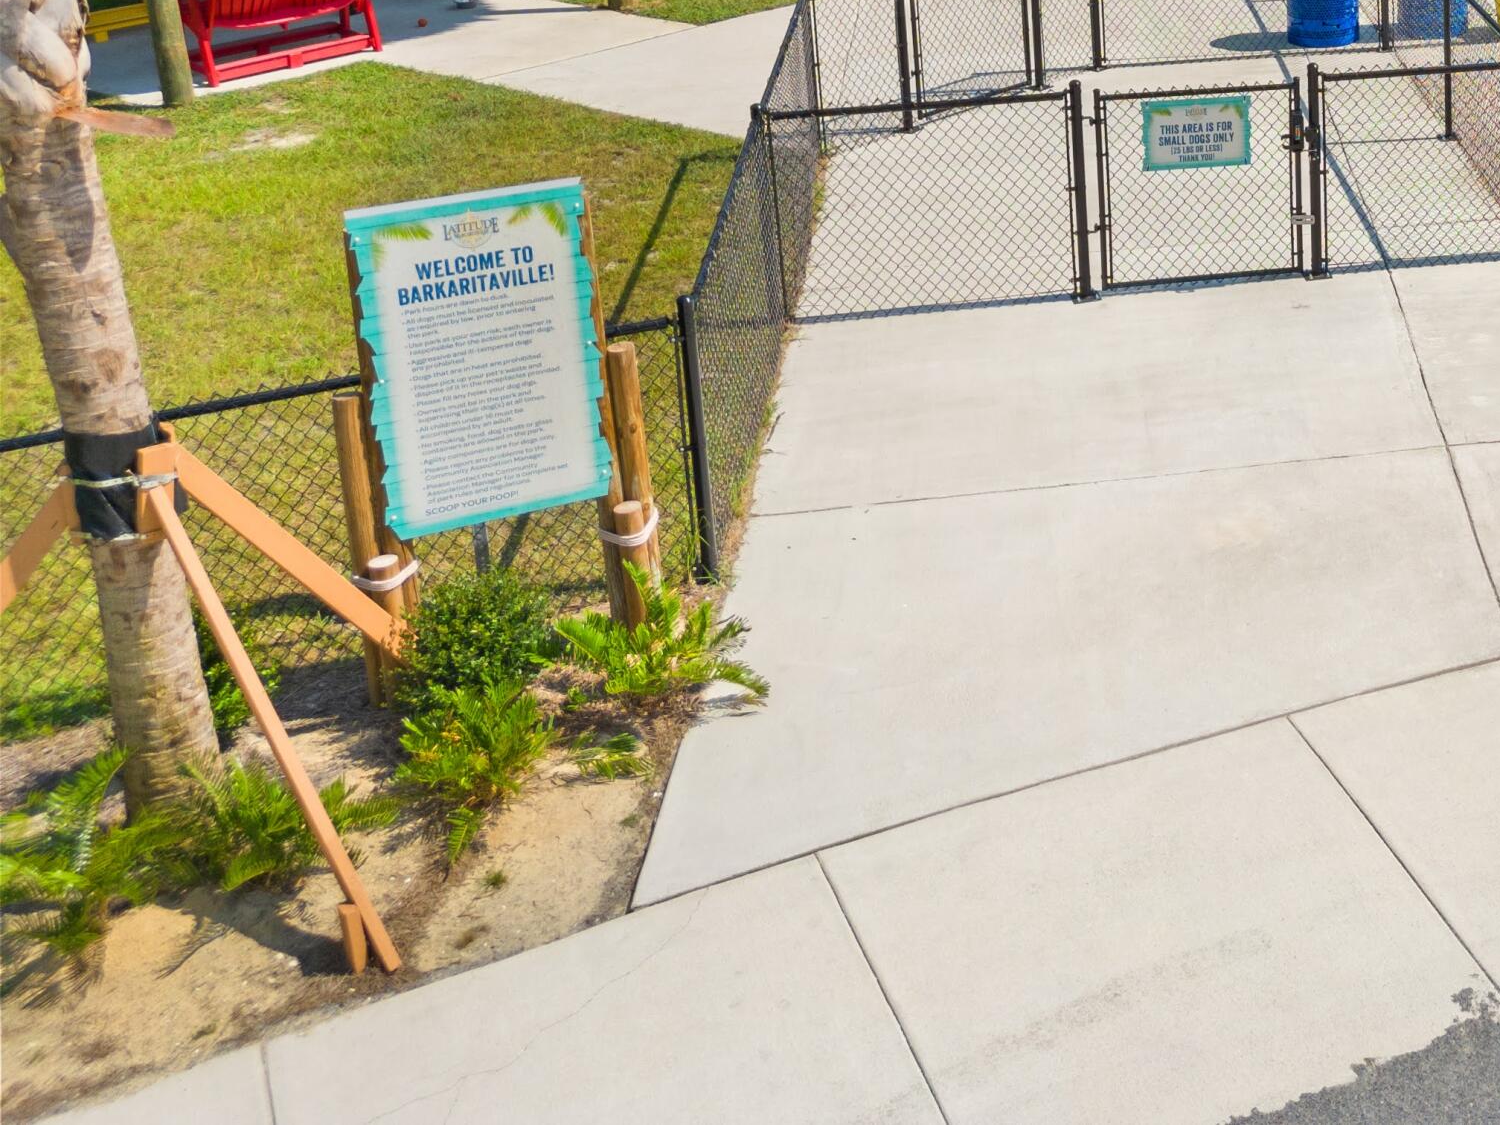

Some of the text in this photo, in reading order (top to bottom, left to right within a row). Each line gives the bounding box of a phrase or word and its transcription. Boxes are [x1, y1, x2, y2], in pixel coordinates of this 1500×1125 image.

[1158, 132, 1234, 146] SMALL DOGS ONLY
[1160, 121, 1232, 135] THIS AREA IS FOR
[1179, 153, 1215, 162] THANK YOU!
[1183, 146, 1195, 154] LBS
[1196, 145, 1204, 153] OR
[442, 217, 500, 242] LATITUDE
[415, 245, 533, 281] WELCOME TO
[397, 263, 555, 306] BARKARITAVILLE!
[403, 307, 421, 315] Park
[422, 303, 444, 312] hours
[458, 297, 479, 306] dawn
[416, 314, 434, 324] dogs
[435, 310, 455, 319] must
[467, 303, 499, 314] licensed
[514, 294, 554, 306] inoculated
[416, 319, 449, 331] required
[476, 311, 494, 321] prior
[504, 304, 536, 316] entering
[408, 342, 453, 356] responsible
[480, 333, 507, 343] actions
[518, 328, 535, 336] their
[536, 324, 555, 334] dogs.
[423, 337, 441, 347] park
[451, 334, 467, 342] your
[502, 324, 521, 332] each
[521, 320, 544, 328] owner
[410, 338, 532, 366] Aggressive and ill-tempered dogs
[412, 372, 431, 382] Dogs
[432, 369, 448, 377] that
[471, 362, 488, 370] heat
[413, 381, 438, 390] Please
[439, 378, 455, 387] pick
[467, 373, 484, 381] your
[505, 365, 527, 373] waste
[414, 387, 444, 399] dispose
[482, 372, 525, 386] receptacles
[527, 366, 560, 378] provided.
[415, 397, 440, 406] Please
[452, 393, 466, 401] any
[466, 388, 487, 397] holes
[488, 386, 505, 394] your
[506, 382, 521, 391] dog
[416, 389, 532, 416] Owners must the park and
[417, 409, 461, 424] supervising
[461, 406, 479, 414] their
[429, 419, 460, 430] children
[461, 415, 483, 424] under
[494, 409, 513, 417] must
[487, 428, 501, 437] dog
[502, 424, 524, 432] treats
[533, 418, 553, 428] glass
[419, 424, 471, 440] accompanied
[421, 442, 462, 455] containers
[476, 434, 504, 445] allowed
[423, 455, 446, 466] Agility
[447, 446, 494, 461] components
[520, 437, 538, 447] dogs
[423, 463, 448, 473] Please
[449, 459, 473, 470] report
[474, 456, 488, 465] any
[489, 449, 524, 462] problems
[534, 444, 546, 452] the
[424, 458, 512, 482] Community Association
[425, 479, 450, 490] Please
[451, 474, 480, 484] contact
[495, 462, 538, 477] Community
[426, 483, 470, 497] Association
[471, 476, 502, 489] Manager
[521, 466, 556, 479] complete
[424, 490, 519, 516] SCOOP YOUR POOP!
[436, 493, 453, 503] park
[454, 489, 473, 498] rules
[474, 486, 488, 494] and
